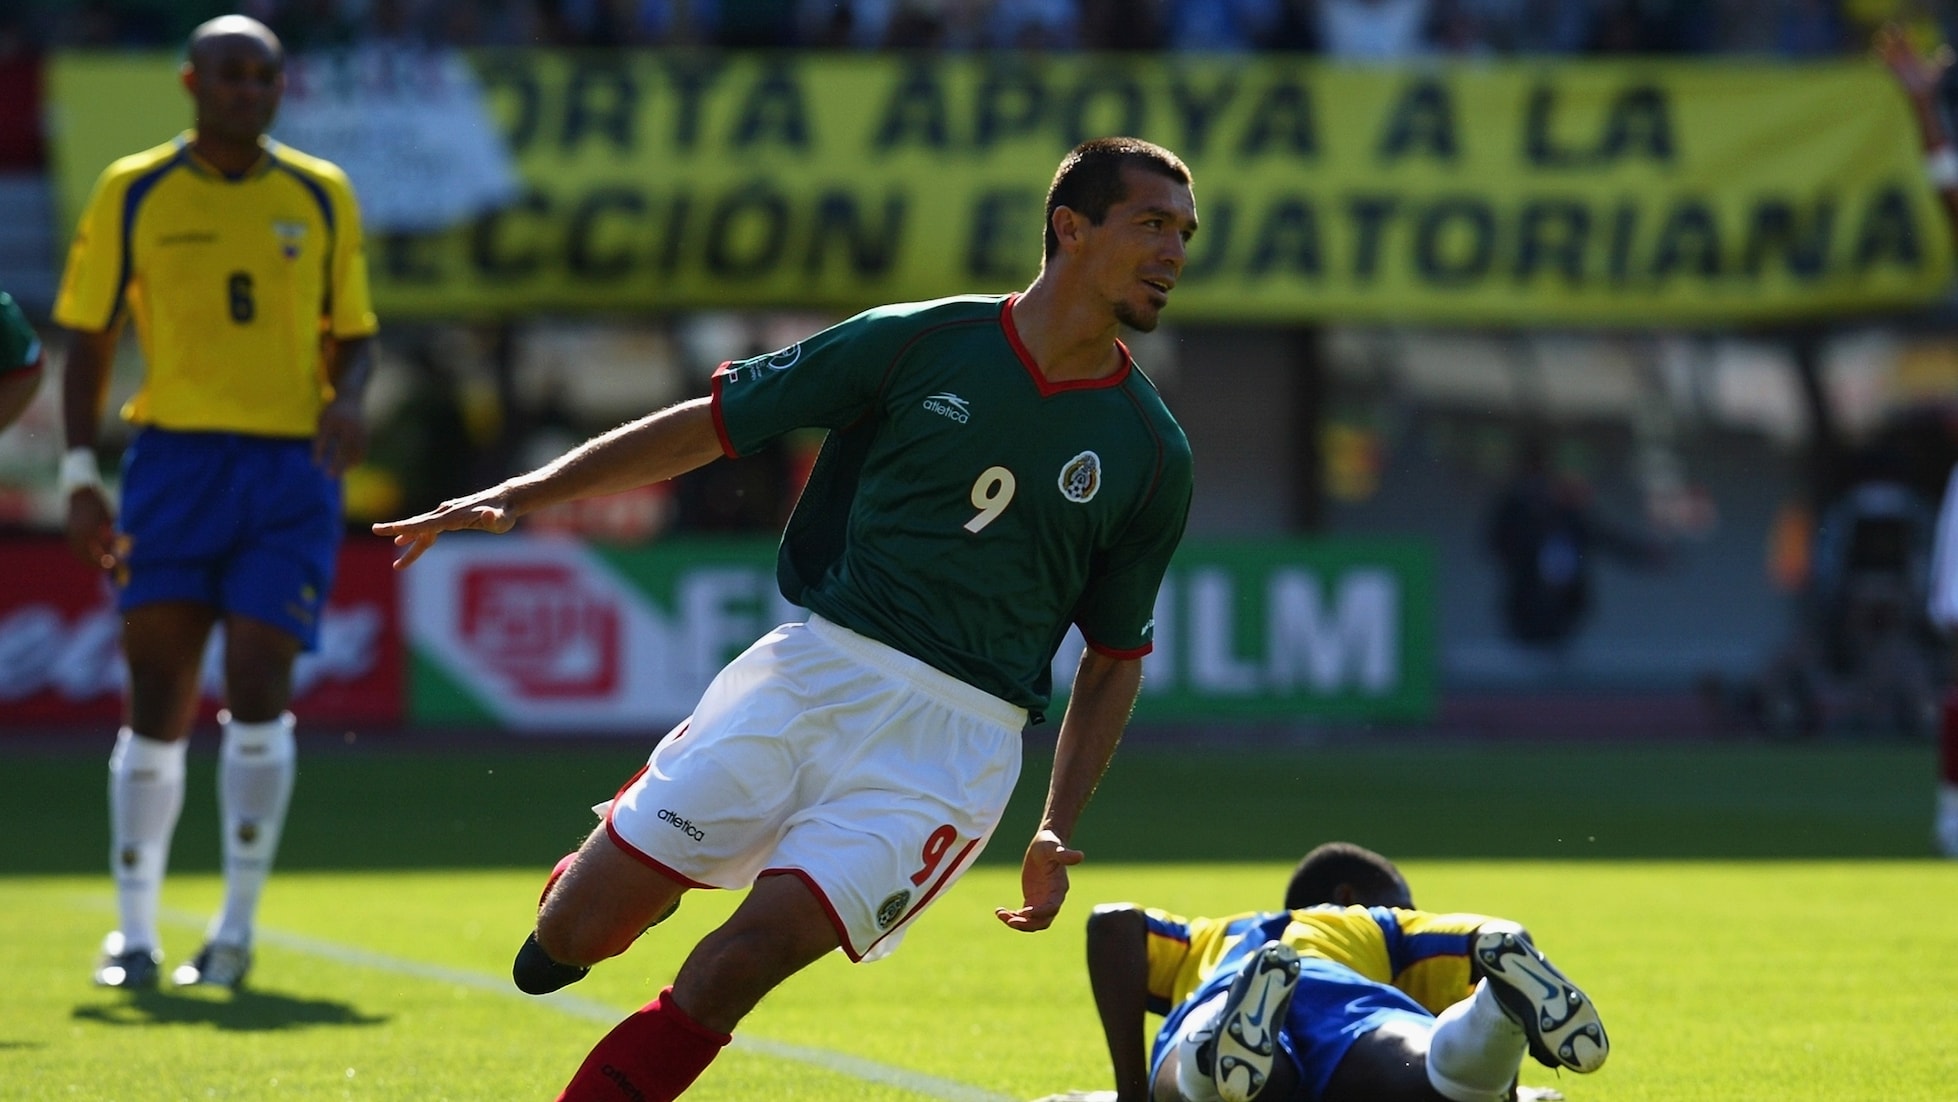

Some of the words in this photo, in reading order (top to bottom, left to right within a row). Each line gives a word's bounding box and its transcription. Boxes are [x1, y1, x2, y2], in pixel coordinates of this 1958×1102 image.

[1376, 80, 1460, 166] A
[1522, 82, 1678, 168] LA
[964, 186, 1924, 290] EUATORIANA
[228, 272, 254, 325] 6
[922, 399, 969, 424] atletica
[963, 465, 1016, 534] 9
[657, 809, 705, 842] atletica
[909, 824, 958, 888] 9
